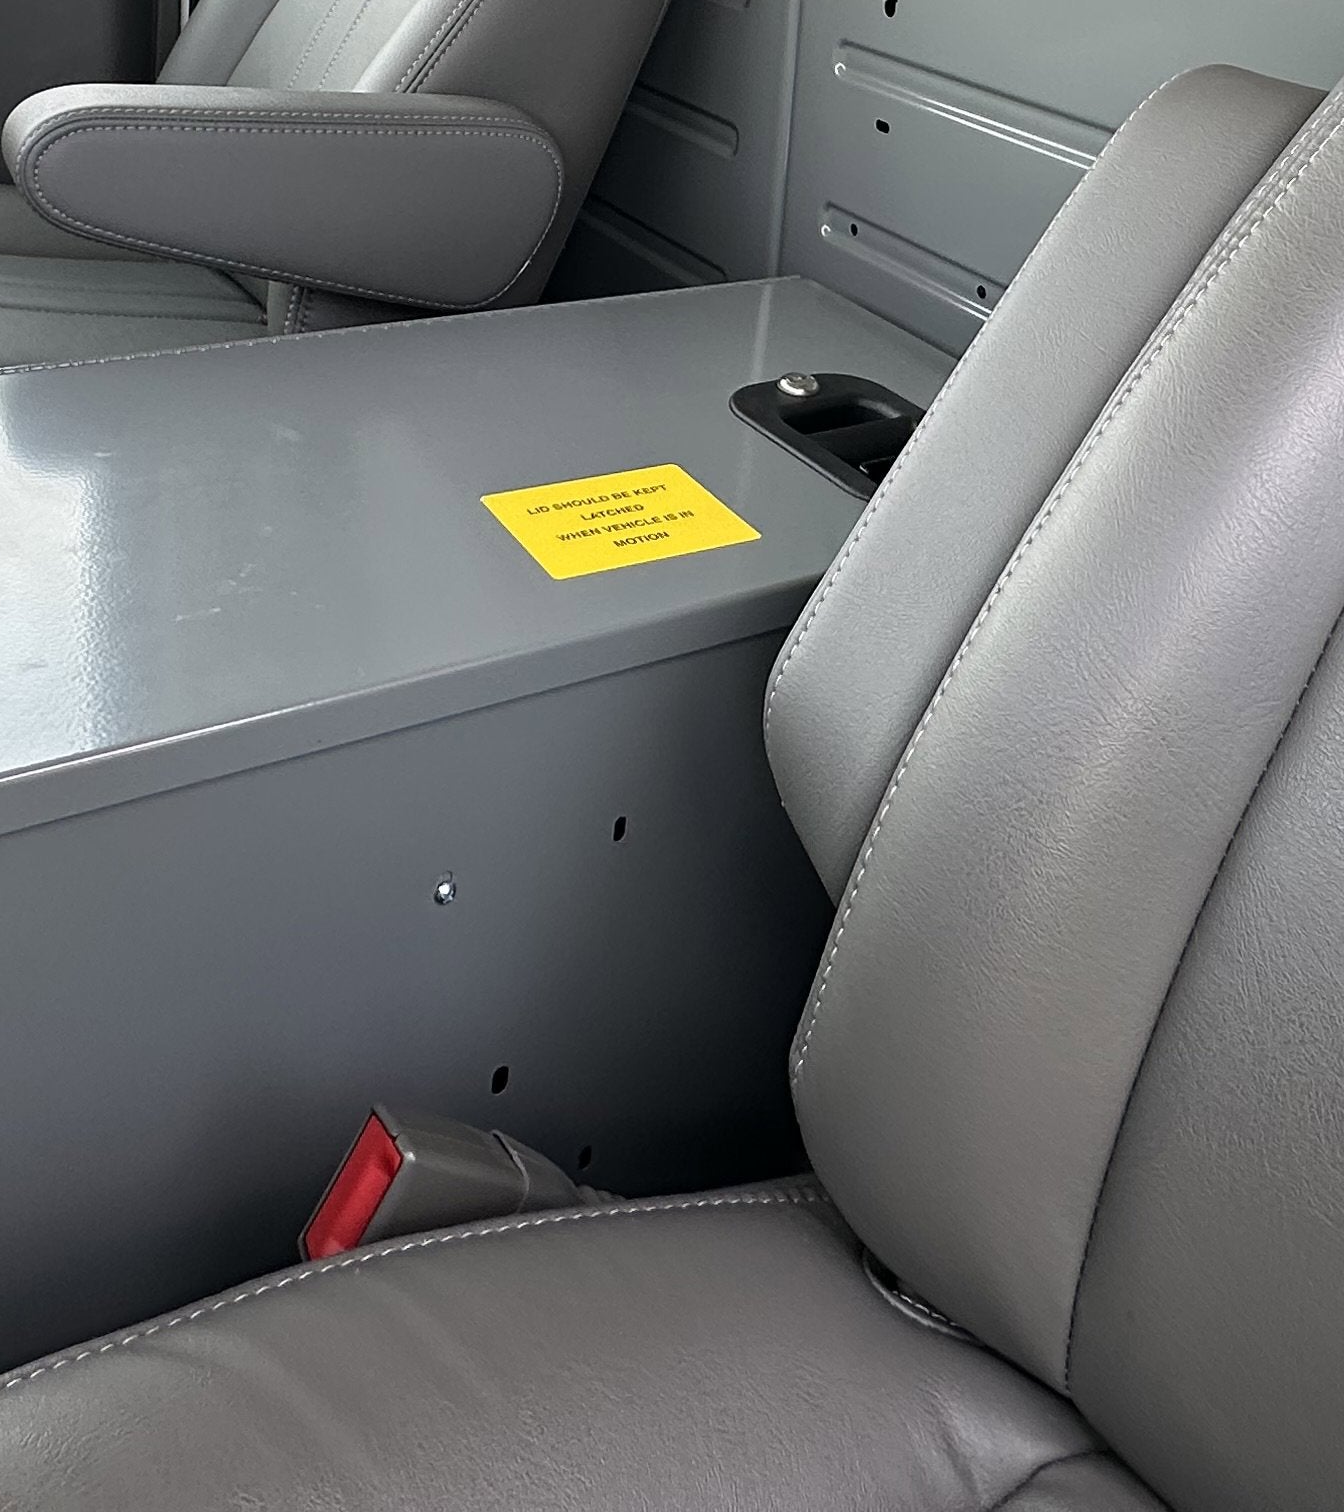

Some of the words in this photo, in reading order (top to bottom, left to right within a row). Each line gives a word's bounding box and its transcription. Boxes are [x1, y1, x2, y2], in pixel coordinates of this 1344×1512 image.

[526, 505, 550, 515] LID
[552, 494, 609, 511] SHOULD
[611, 491, 631, 500] BE
[633, 483, 668, 497] KEPT
[580, 503, 645, 521] LATCHED
[556, 527, 601, 542] WHEN
[601, 516, 662, 533] VEHICLE
[664, 513, 678, 522] IS
[679, 509, 695, 519] IN
[613, 531, 670, 548] MOTION
